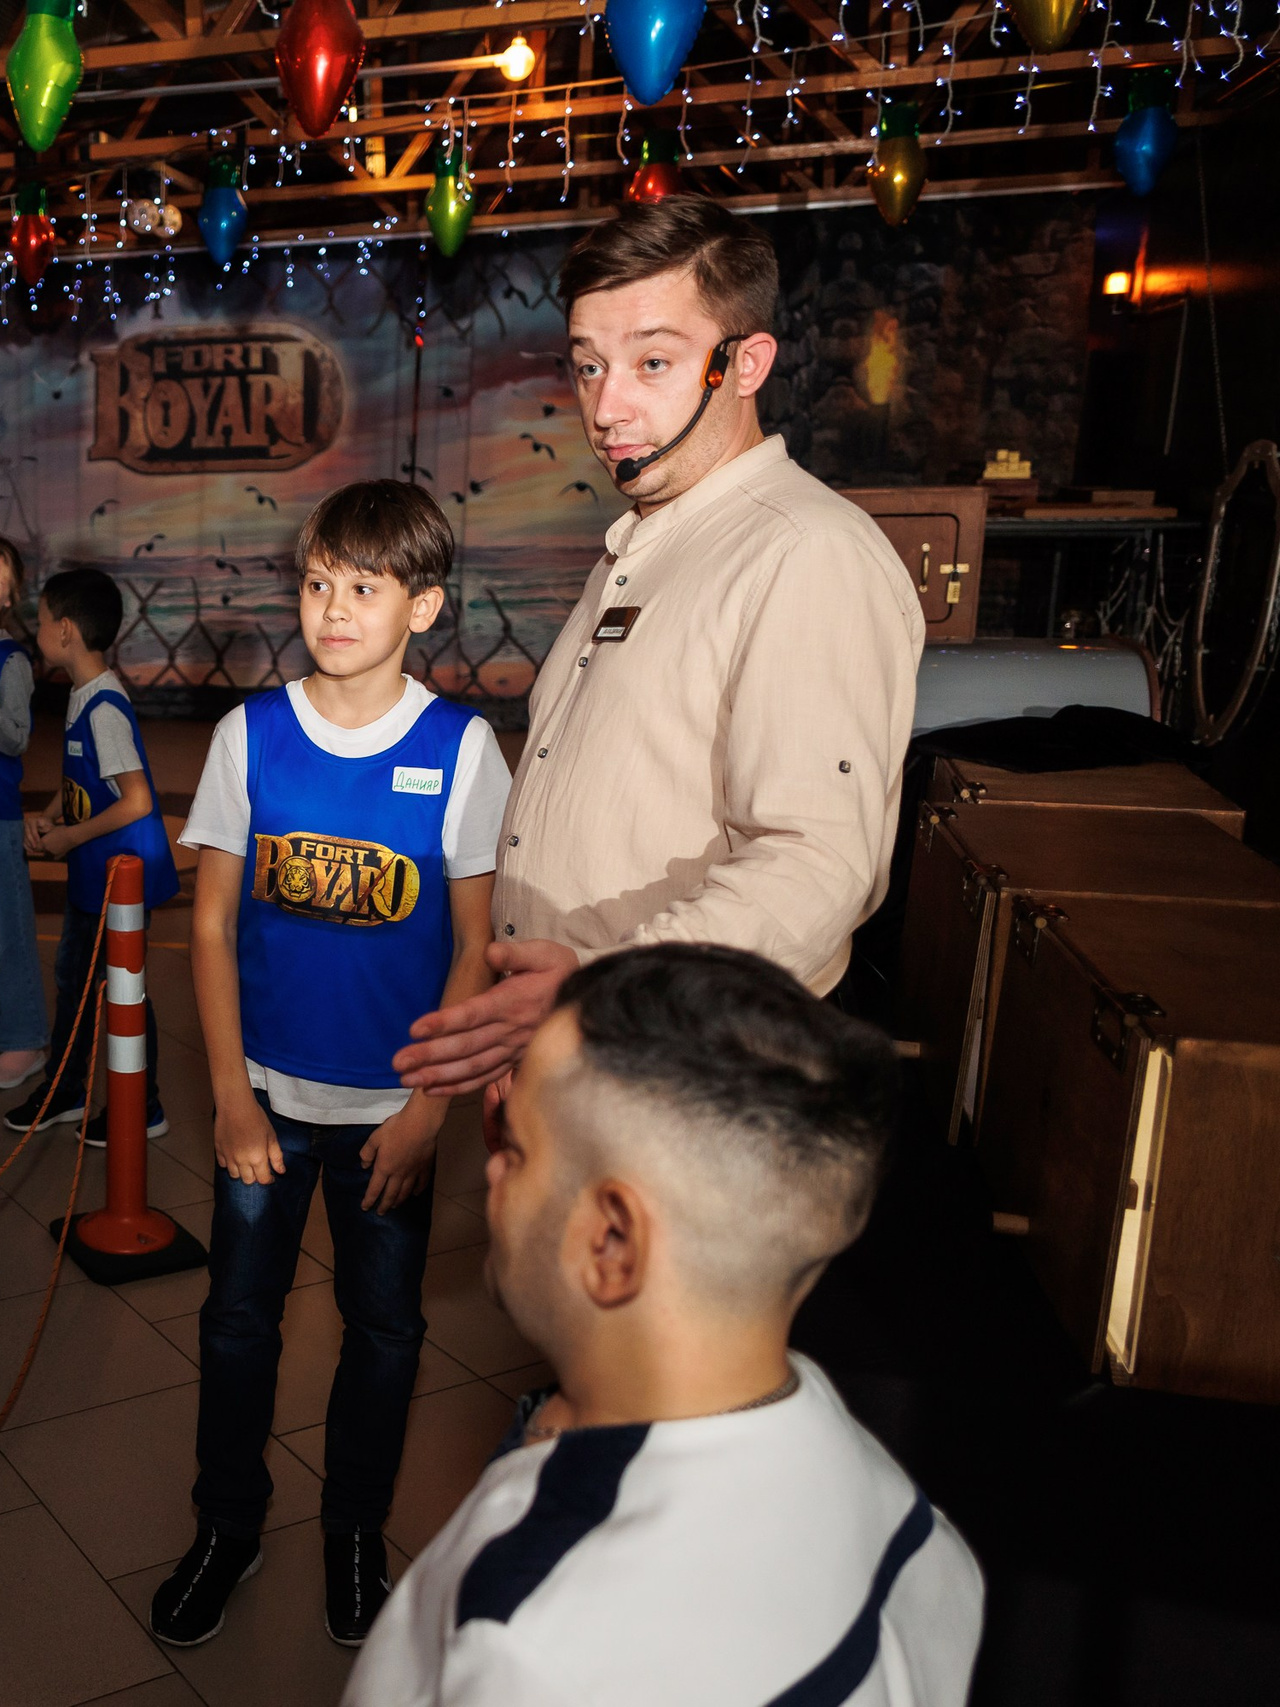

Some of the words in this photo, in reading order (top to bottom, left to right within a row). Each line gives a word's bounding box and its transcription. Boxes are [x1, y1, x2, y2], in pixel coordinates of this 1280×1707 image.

[152, 341, 271, 373] FORT
[88, 341, 344, 461] BOYARD
[300, 841, 370, 865] FORT
